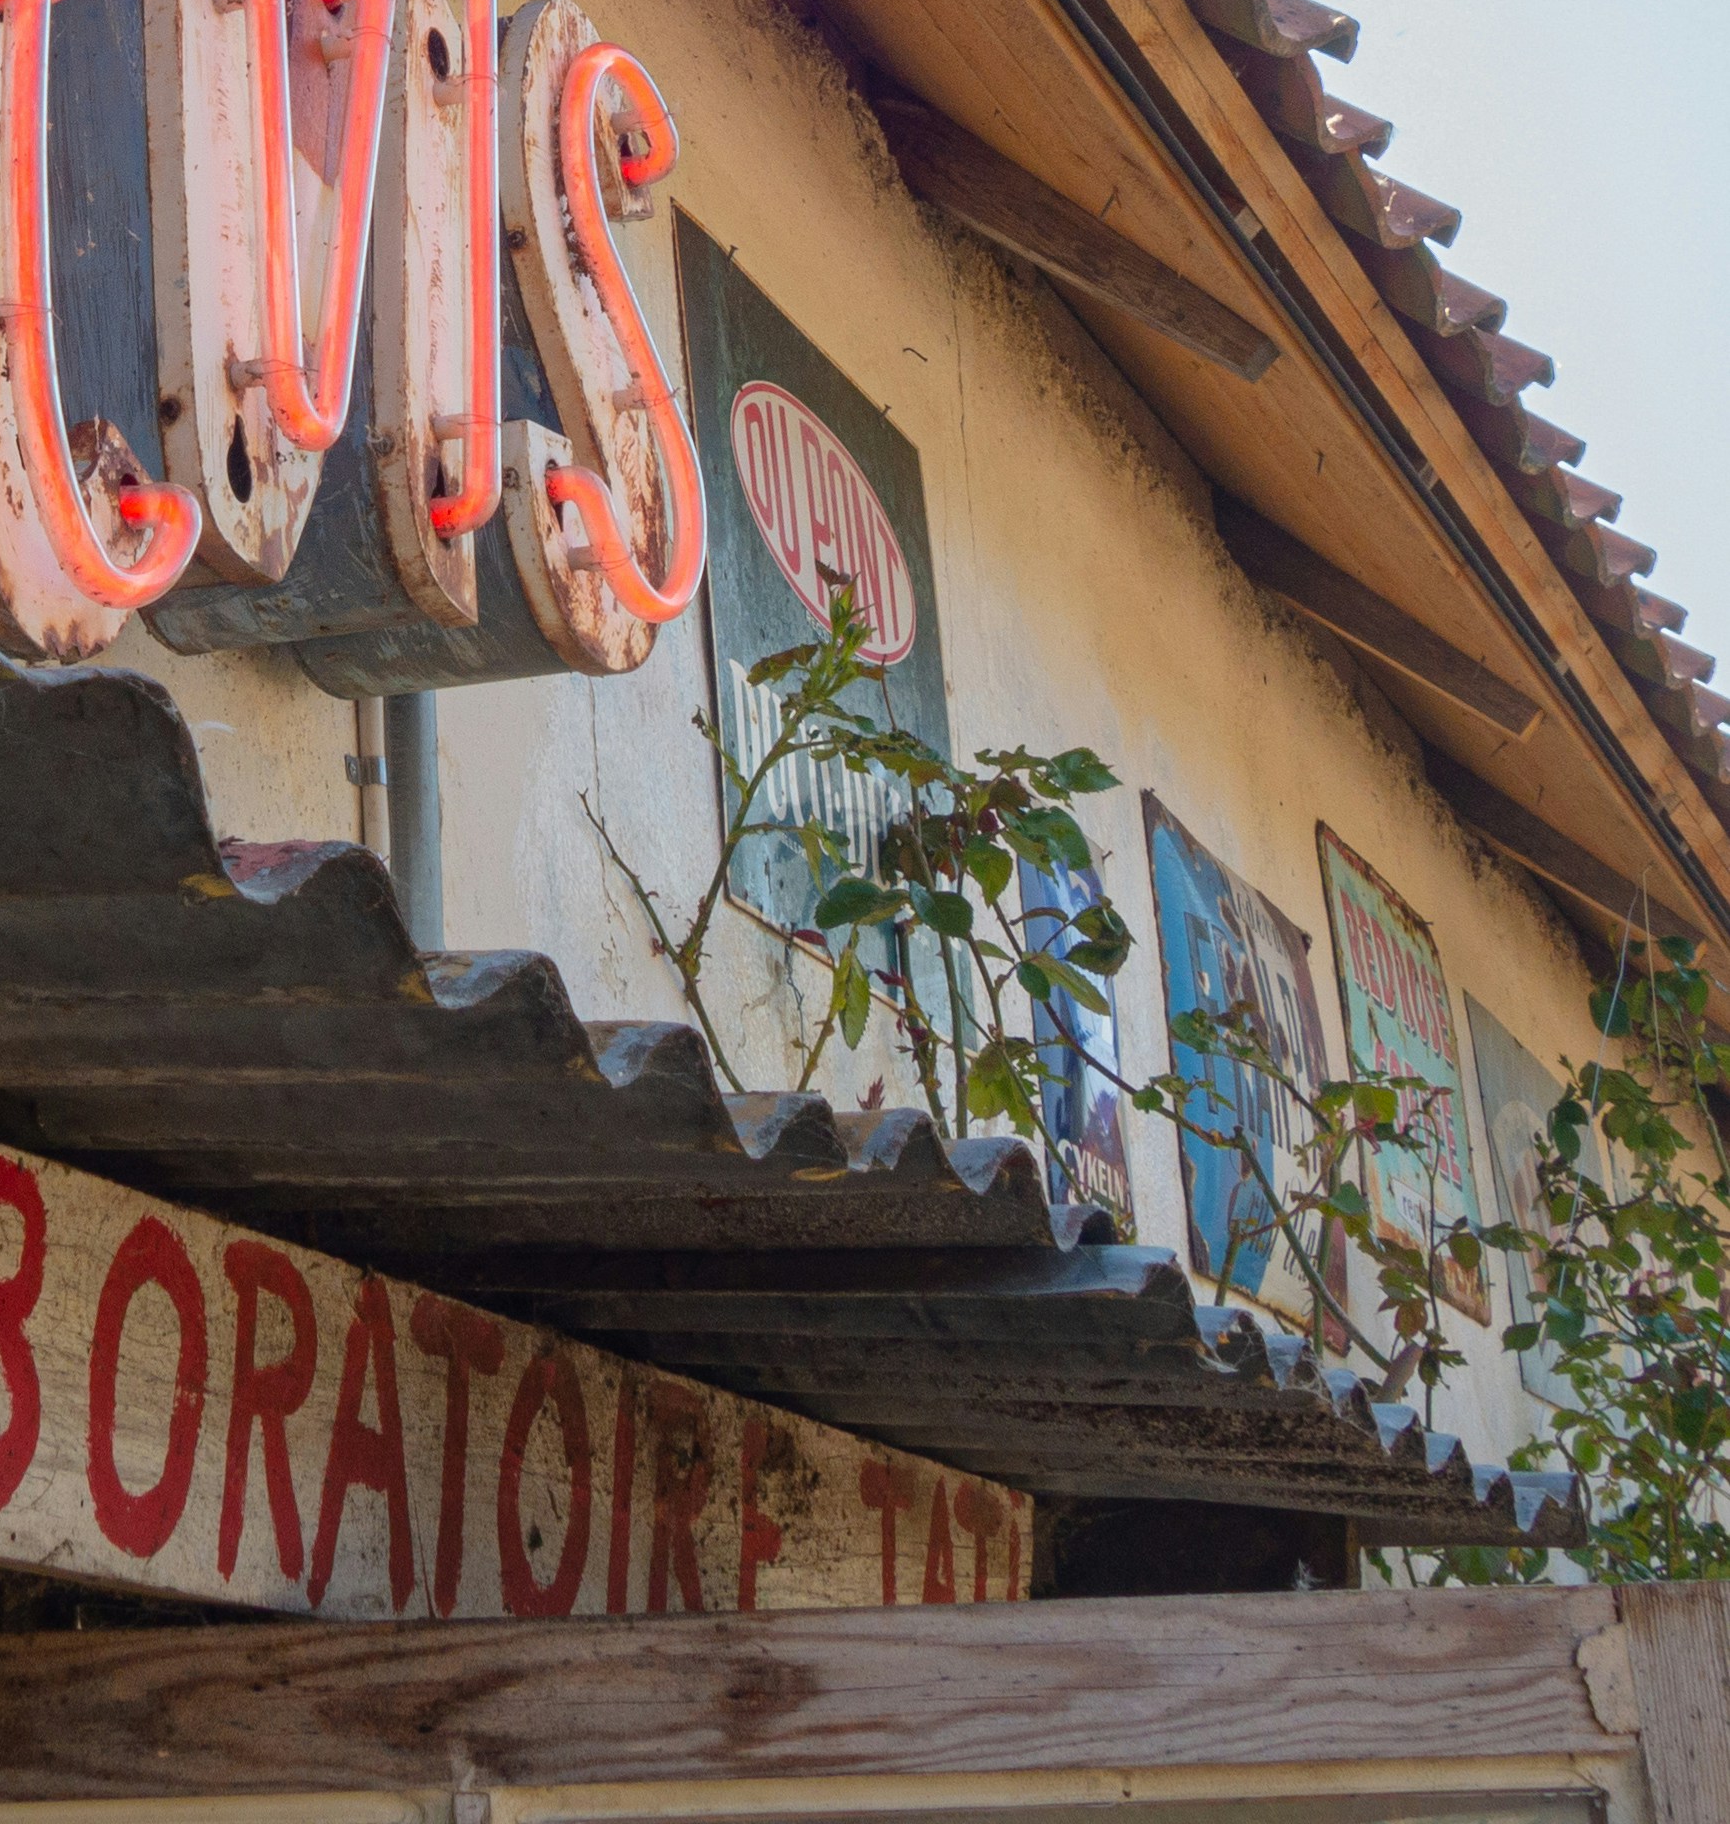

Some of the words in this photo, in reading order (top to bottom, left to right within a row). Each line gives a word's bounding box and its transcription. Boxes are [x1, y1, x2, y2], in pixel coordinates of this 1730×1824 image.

[743, 400, 802, 576] DU
[798, 417, 901, 646] PONT
[1339, 888, 1396, 1017] RED
[1391, 933, 1455, 1071] ROSE
